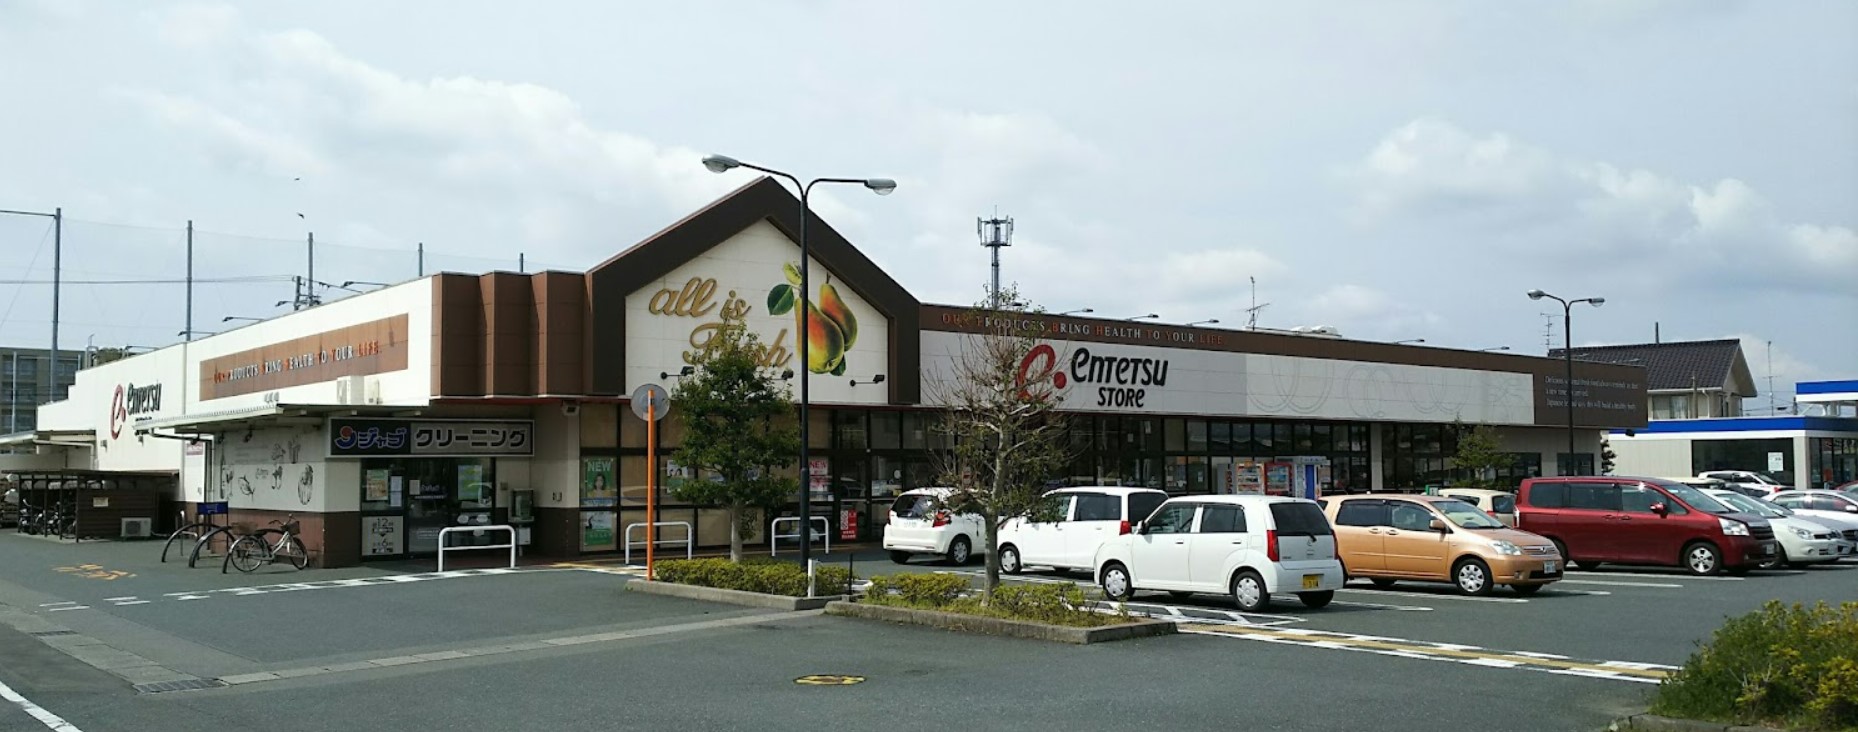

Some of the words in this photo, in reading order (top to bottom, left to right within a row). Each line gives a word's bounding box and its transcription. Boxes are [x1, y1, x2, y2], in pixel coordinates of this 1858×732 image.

[648, 276, 718, 318] all
[1050, 323, 1090, 336] BRING
[1095, 325, 1142, 340] HEALTH
[1146, 329, 1161, 340] TO
[1165, 330, 1195, 344] YOUR
[356, 426, 407, 449] ジャブ
[415, 427, 527, 449] クリーニング
[587, 461, 612, 472] NEW
